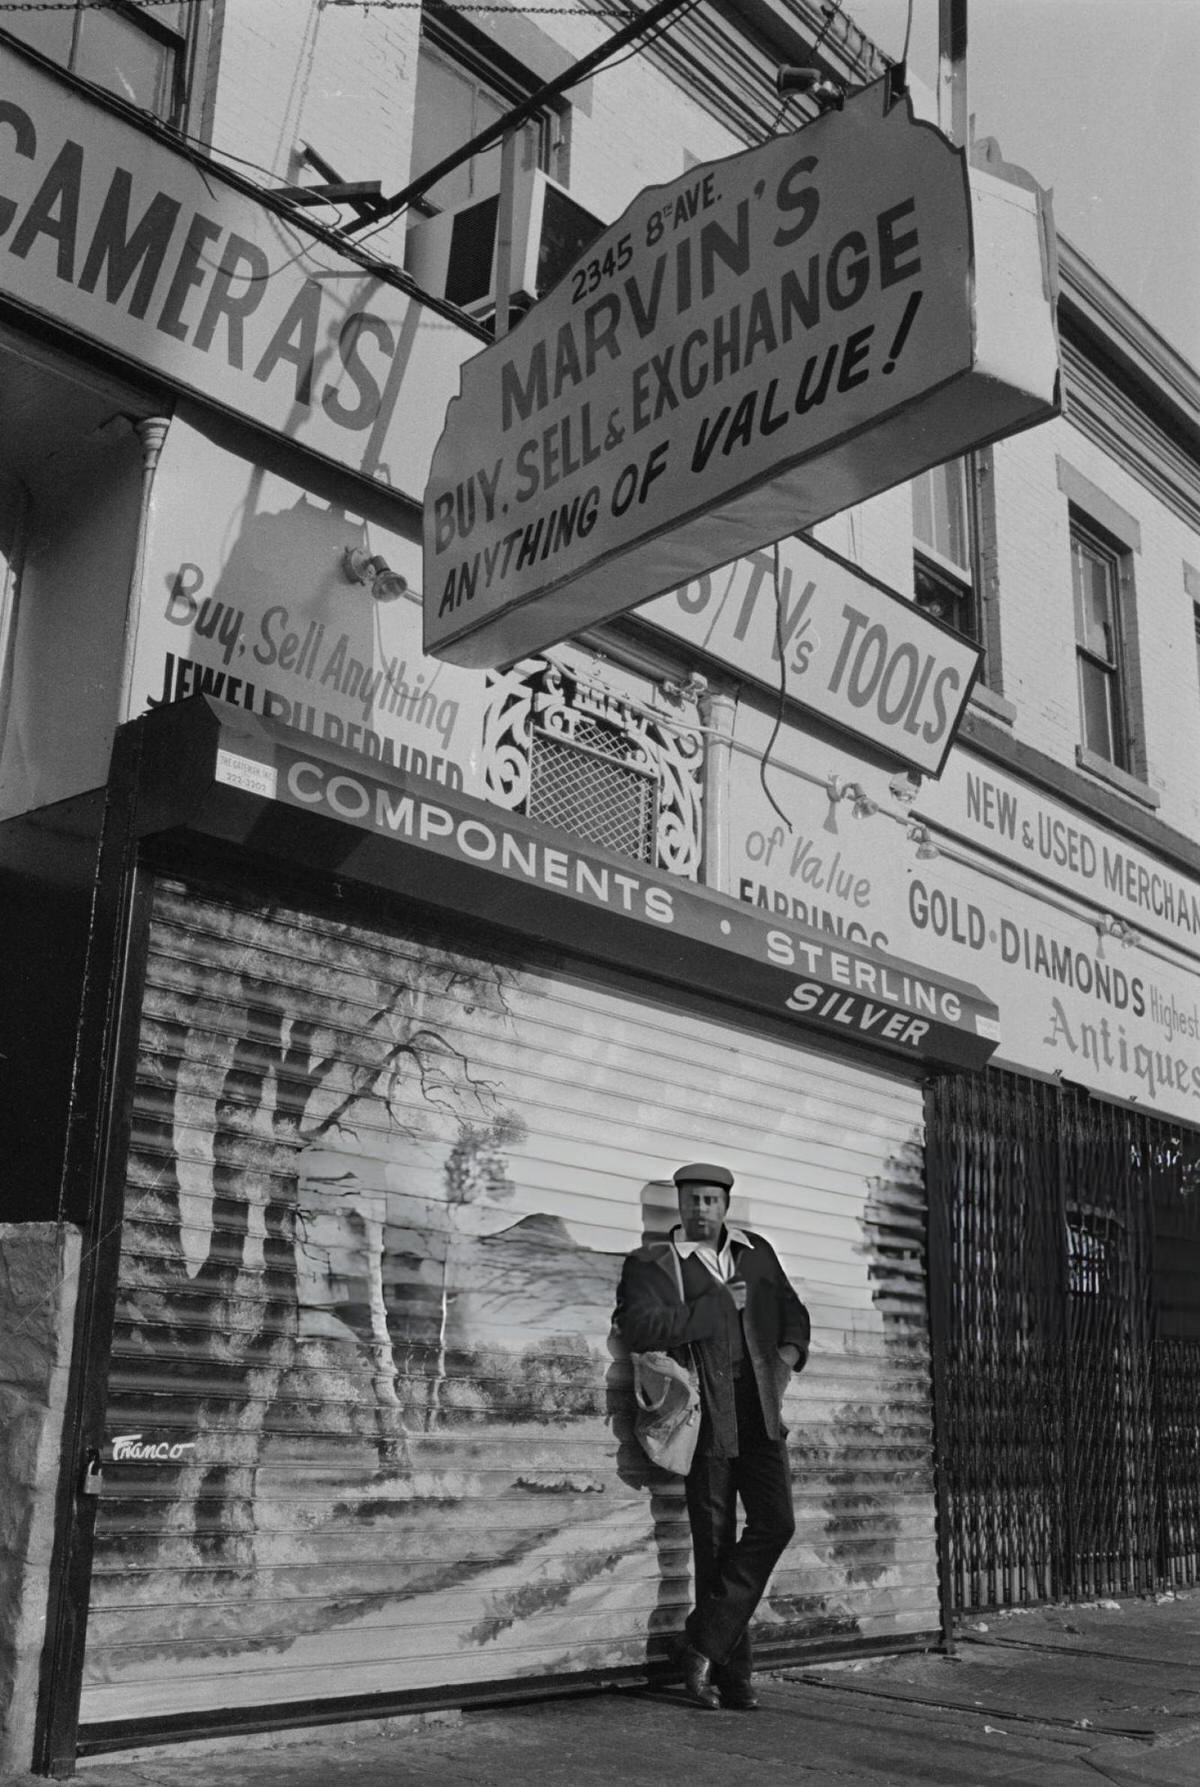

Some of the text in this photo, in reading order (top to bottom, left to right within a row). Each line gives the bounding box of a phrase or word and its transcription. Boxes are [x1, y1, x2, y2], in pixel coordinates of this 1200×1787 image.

[501, 156, 819, 433] MARVIN'S
[571, 232, 633, 305] 2345
[674, 172, 722, 231] AVE.
[633, 196, 922, 434] EXCHANGE
[438, 485, 600, 618] ANYTHING
[611, 440, 669, 517] OF
[253, 605, 326, 680] Sell
[319, 634, 460, 750] Anything
[827, 604, 960, 744] TOOLS
[287, 761, 962, 1022] COMPONENTS STERLING
[790, 836, 871, 908] Value
[967, 771, 1017, 840] NEW
[1022, 820, 1034, 850] &
[1038, 811, 1097, 879] USED
[785, 983, 930, 1046] SILVER
[909, 879, 1145, 1017] GOLD DIAMONDS
[1150, 984, 1200, 1042] Highest
[112, 1433, 195, 1460] Franco
